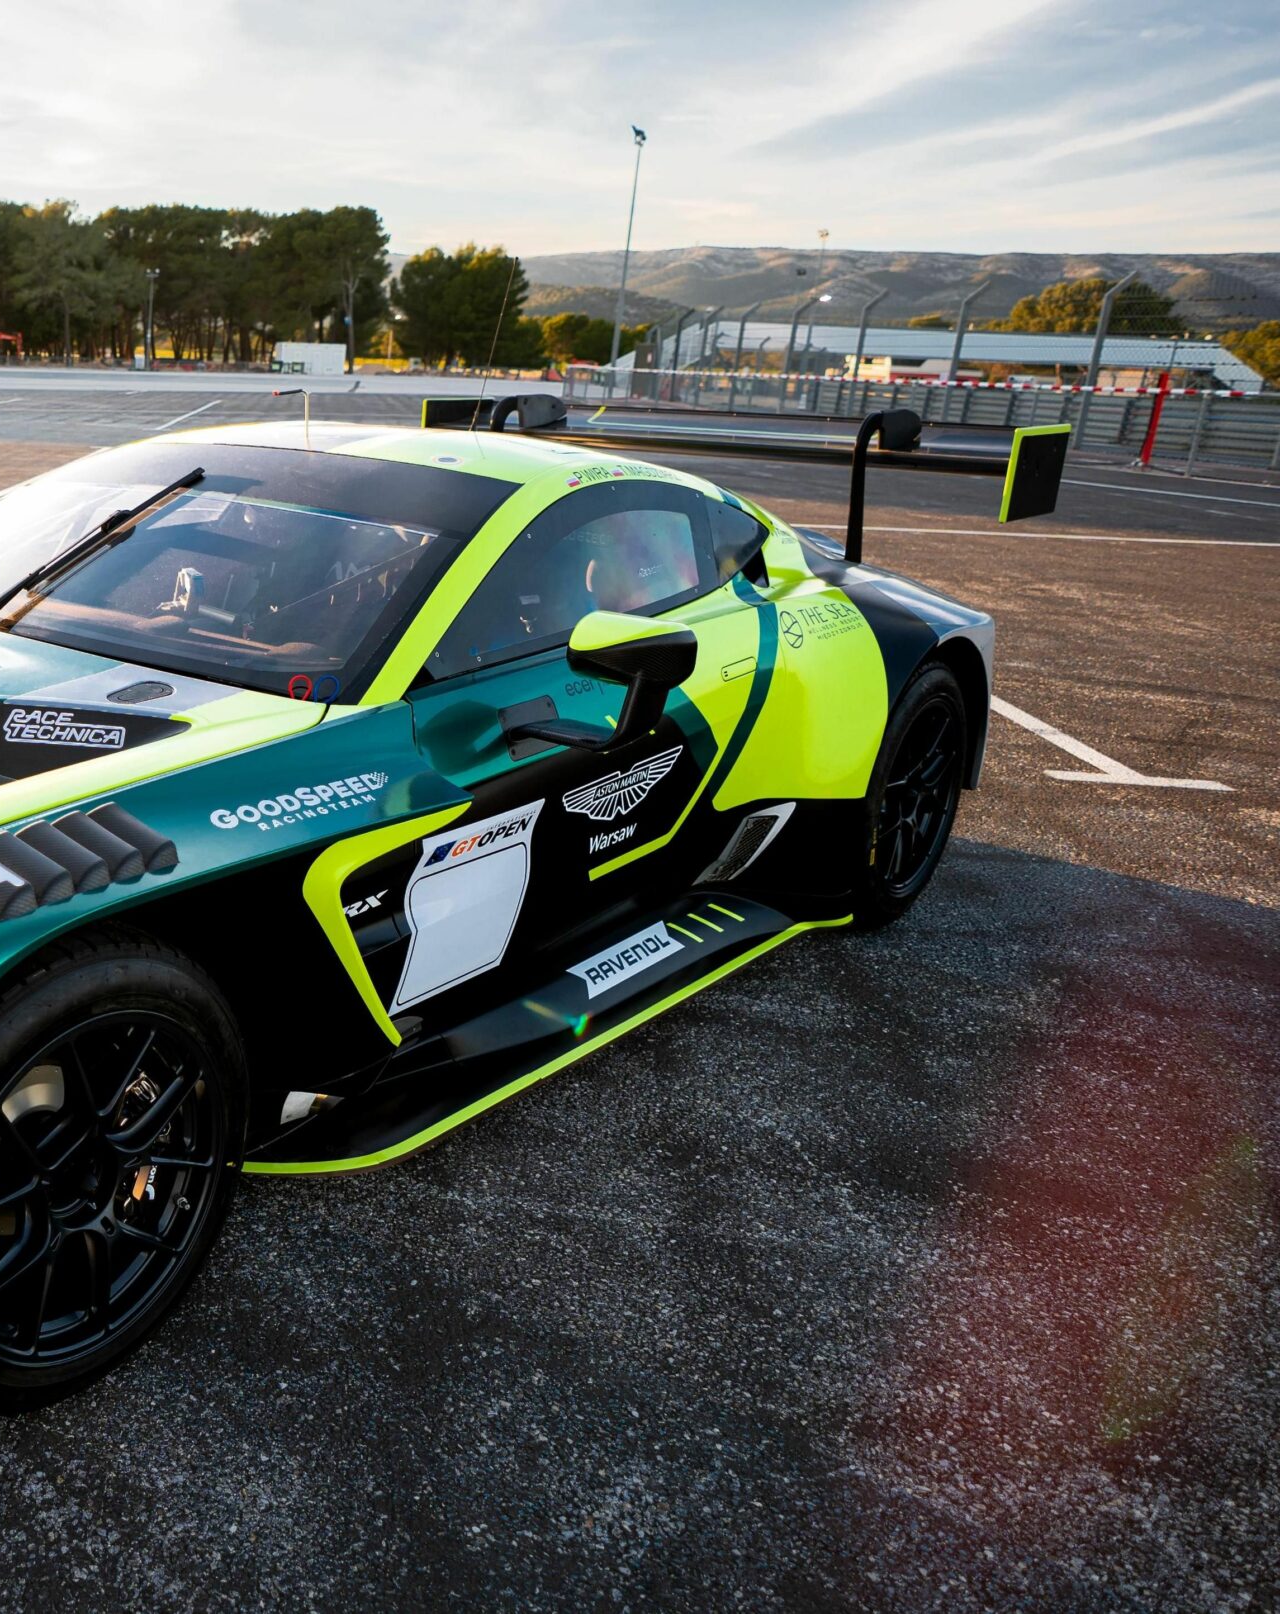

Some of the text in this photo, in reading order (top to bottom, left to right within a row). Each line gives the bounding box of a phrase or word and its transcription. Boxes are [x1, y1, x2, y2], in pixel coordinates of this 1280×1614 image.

[797, 603, 856, 627] THE SEA
[5, 708, 74, 725] RACE
[10, 723, 121, 745] TECHNICA
[210, 771, 388, 829] GOODSPEED
[594, 768, 649, 800] ASTON MARTIN
[589, 822, 638, 855] Warsaw
[584, 934, 671, 985] RAVENOL
